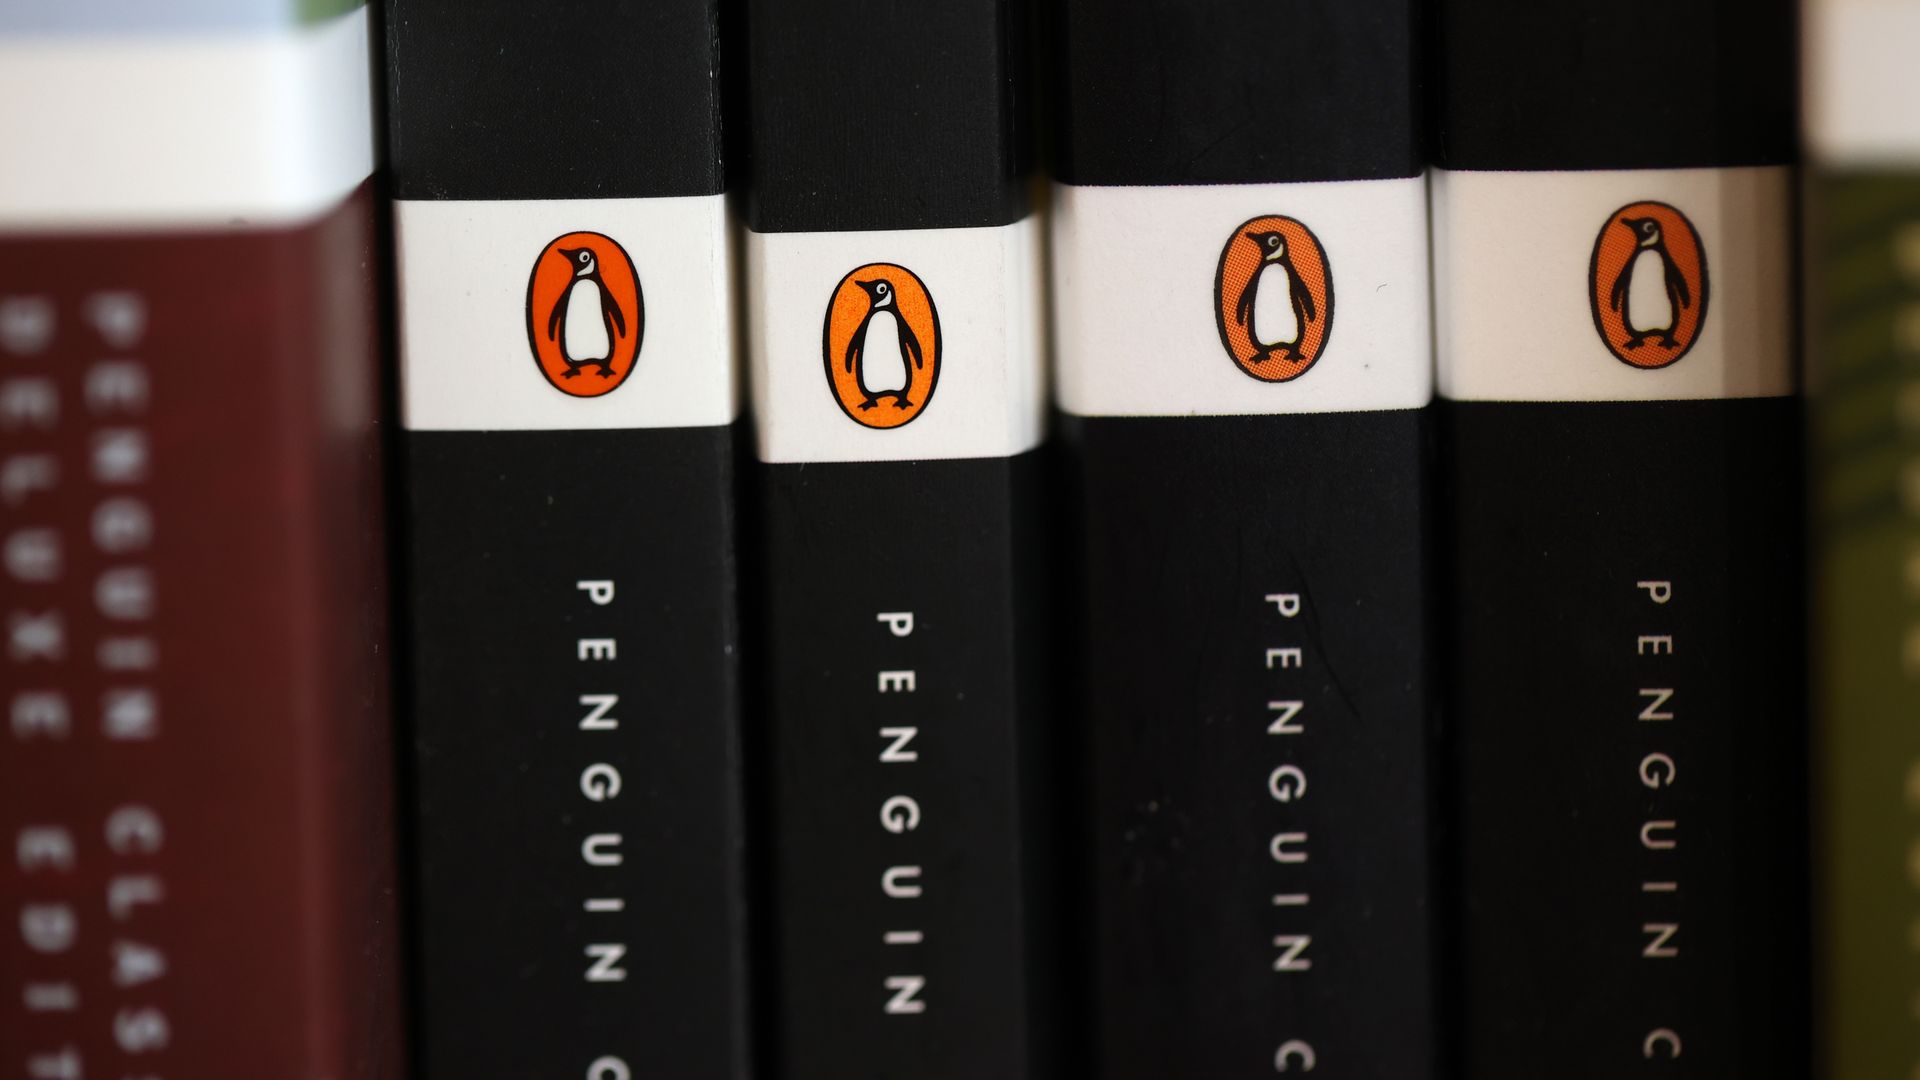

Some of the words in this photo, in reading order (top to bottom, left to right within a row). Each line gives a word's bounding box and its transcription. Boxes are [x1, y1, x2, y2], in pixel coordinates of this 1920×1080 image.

[0, 295, 69, 740] DELUXE
[84, 291, 158, 740] PENGUIN
[105, 804, 170, 1080] CLAS
[576, 579, 625, 983] PENGUIN
[876, 611, 925, 1015] PENGUIN
[1265, 593, 1311, 971] PENGUIN
[1637, 580, 1678, 957] PENGUIN
[1276, 1041, 1315, 1069] C
[1643, 1028, 1681, 1058] C
